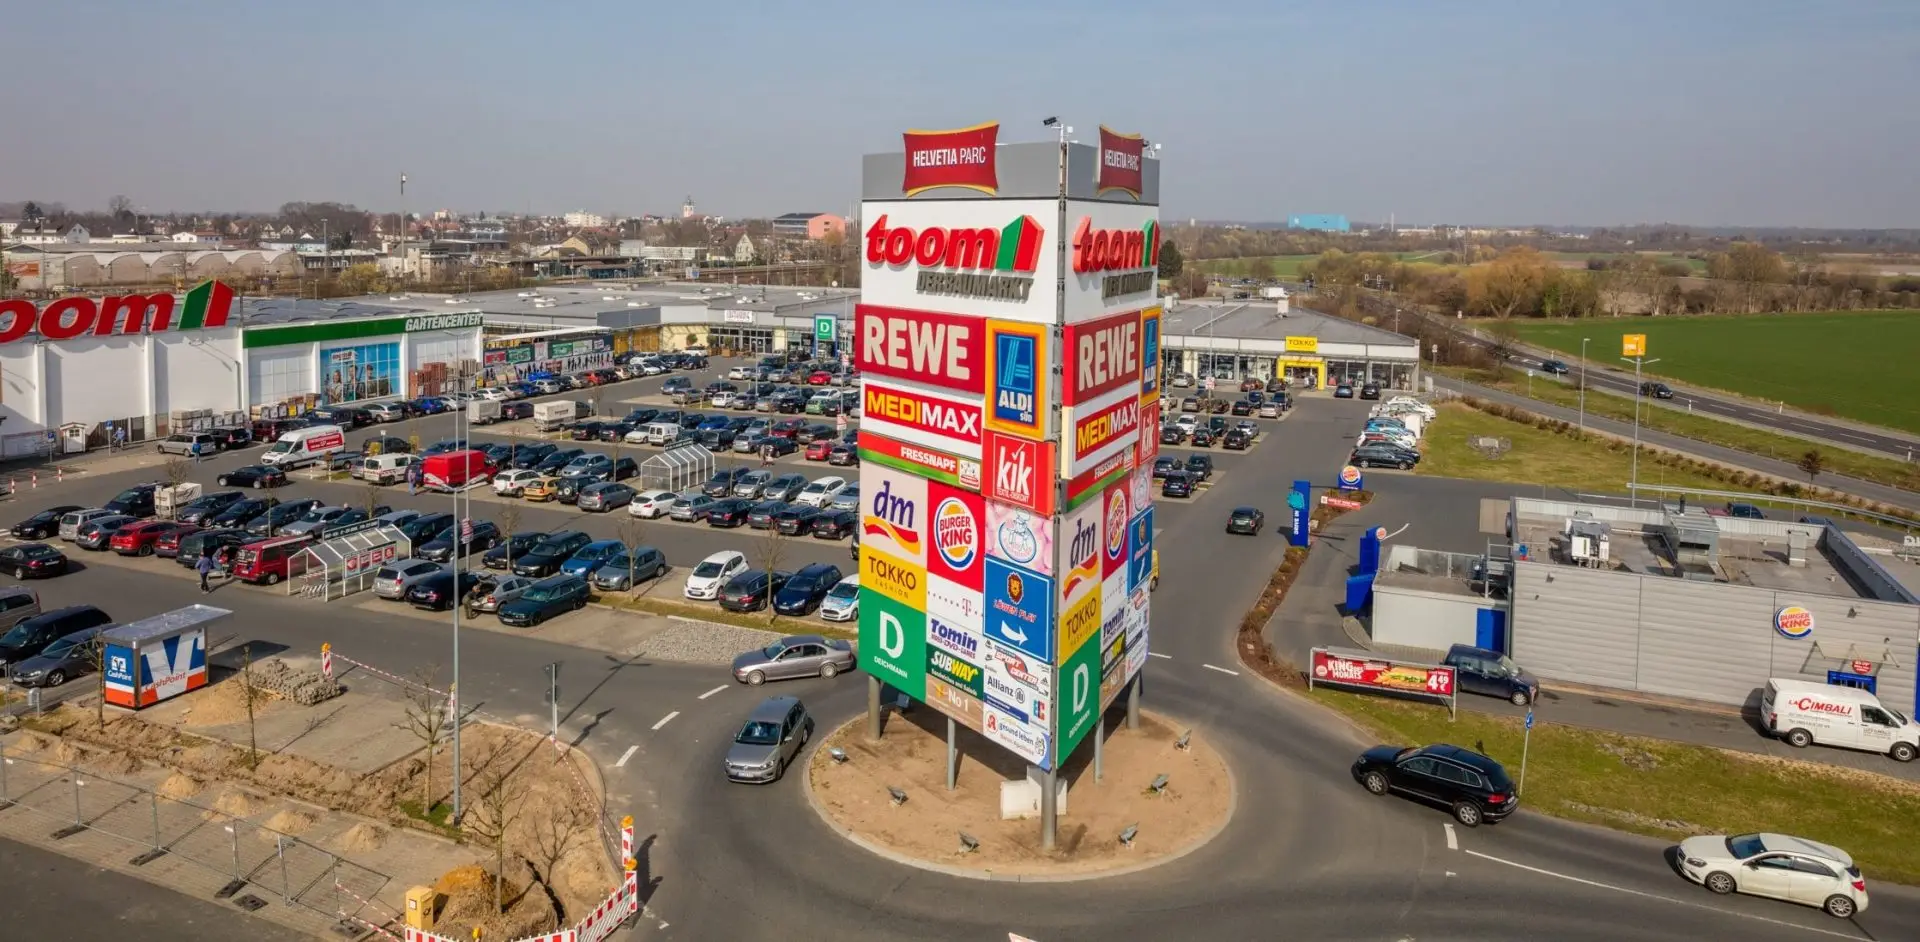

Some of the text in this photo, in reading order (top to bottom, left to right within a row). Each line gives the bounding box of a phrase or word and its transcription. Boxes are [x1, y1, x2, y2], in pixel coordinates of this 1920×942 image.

[913, 146, 986, 167] HELVETIA PARC
[1104, 149, 1140, 171] HELVETIA PARC
[405, 313, 483, 331] GARTENCENTER
[863, 315, 970, 380] REWE
[1078, 321, 1136, 392] REWE
[998, 389, 1032, 413] ALDI
[867, 391, 979, 437] MEDIMAX
[1077, 401, 1137, 453] MEDIMAX
[901, 446, 956, 471] FRESSNAPF
[874, 480, 914, 528] dm
[940, 516, 971, 531] BURGER
[941, 528, 972, 548] KING
[1070, 518, 1096, 569] dm
[1780, 612, 1810, 621] BURGER
[1780, 619, 1811, 629] KING
[880, 611, 904, 658] D
[108, 669, 132, 681] CashPoint
[874, 656, 908, 679] DEICHMANN
[931, 650, 978, 682] SUBWAY
[1328, 659, 1353, 672] KING
[988, 676, 1014, 697] Allianz
[1073, 663, 1089, 716] D
[1798, 697, 1852, 715] CIMBALI
